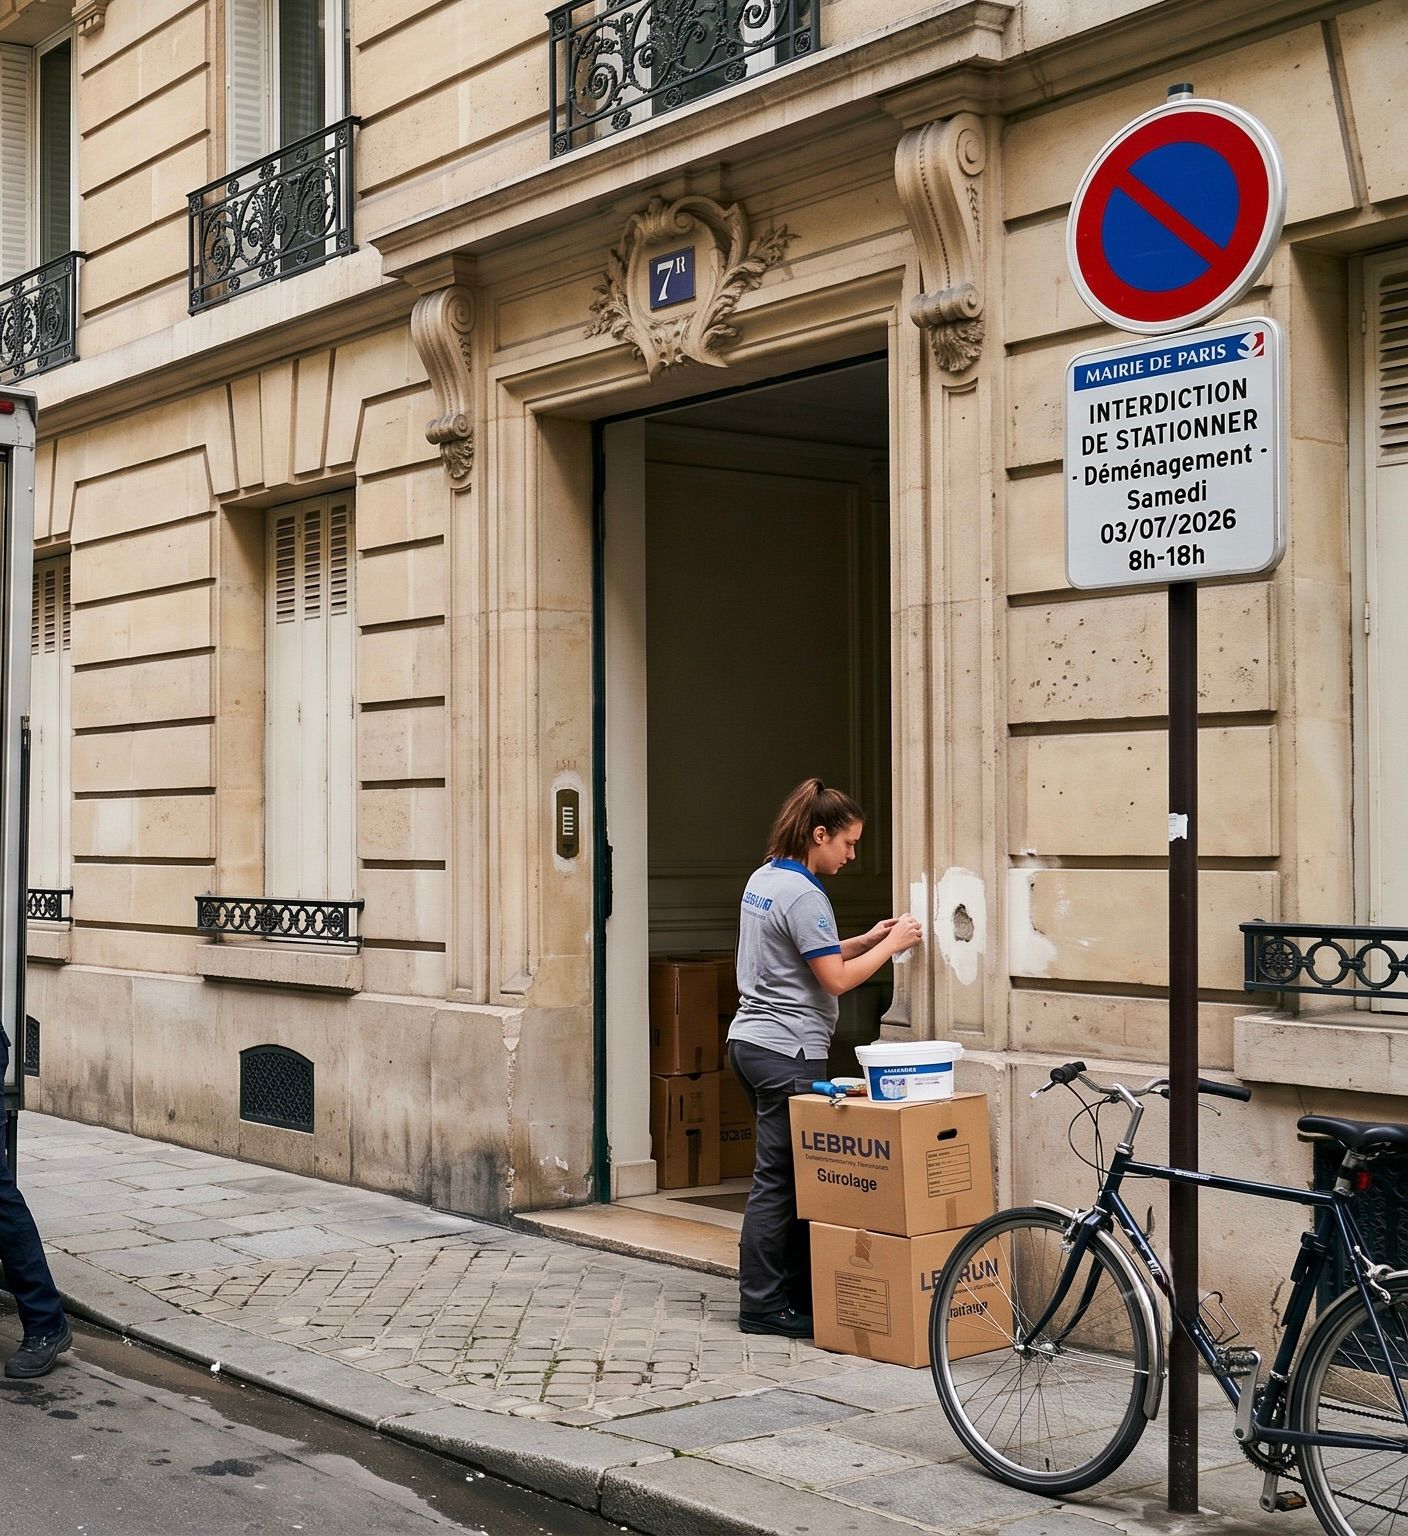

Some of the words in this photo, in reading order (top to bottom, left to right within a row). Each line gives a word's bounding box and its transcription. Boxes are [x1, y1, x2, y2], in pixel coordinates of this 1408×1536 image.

[1085, 359, 1144, 384] MAIRIE
[1149, 354, 1172, 371] DE
[1178, 343, 1227, 366] PARIS
[1089, 378, 1248, 424] INTERDICTION
[1082, 433, 1108, 456] DE
[1116, 408, 1258, 450] STATIONNER
[1084, 443, 1253, 486] Déménagement
[1127, 480, 1208, 510] Samedi
[1100, 508, 1237, 544] 03/07/2026
[1128, 544, 1205, 570] 8h-18h
[801, 1130, 890, 1160] LEBRUN
[921, 1258, 999, 1291] LERUN
